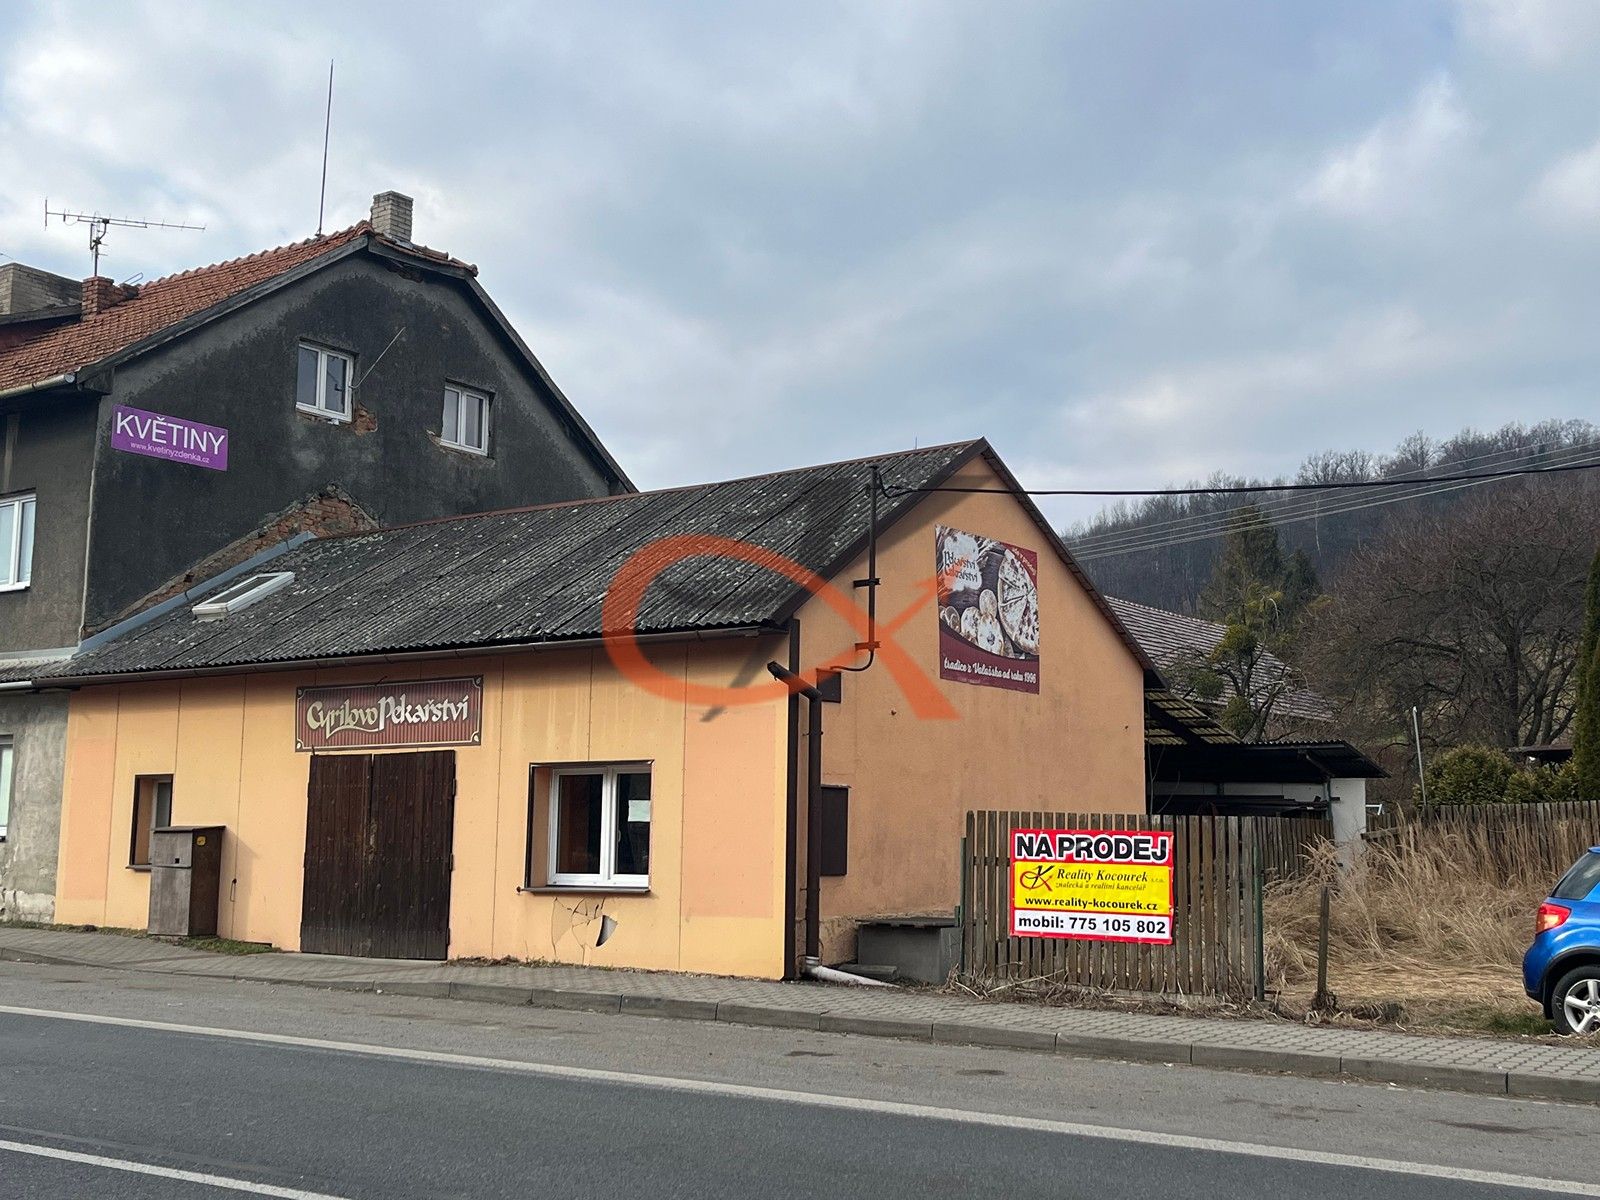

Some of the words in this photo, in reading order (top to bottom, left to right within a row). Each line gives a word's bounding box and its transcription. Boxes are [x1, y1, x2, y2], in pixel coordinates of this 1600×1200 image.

[116, 411, 225, 456] KVĚTINY
[944, 657, 966, 672] tradice
[1024, 672, 1037, 684] 1996
[306, 698, 379, 740] Cyrilovo
[378, 693, 469, 731] Pekařství
[1016, 835, 1053, 858] NA
[1057, 835, 1168, 861] PRODEJ
[1056, 881, 1083, 889] znalecká
[1116, 883, 1146, 891] kancelář
[1057, 868, 1093, 882] Reality
[1096, 869, 1148, 882] Kocourek
[1025, 896, 1158, 911] www.reality-kocourek.cz
[1018, 915, 1064, 929] mobil:
[1069, 917, 1097, 930] 775
[1103, 919, 1131, 932] 105
[1136, 920, 1166, 934] 802
